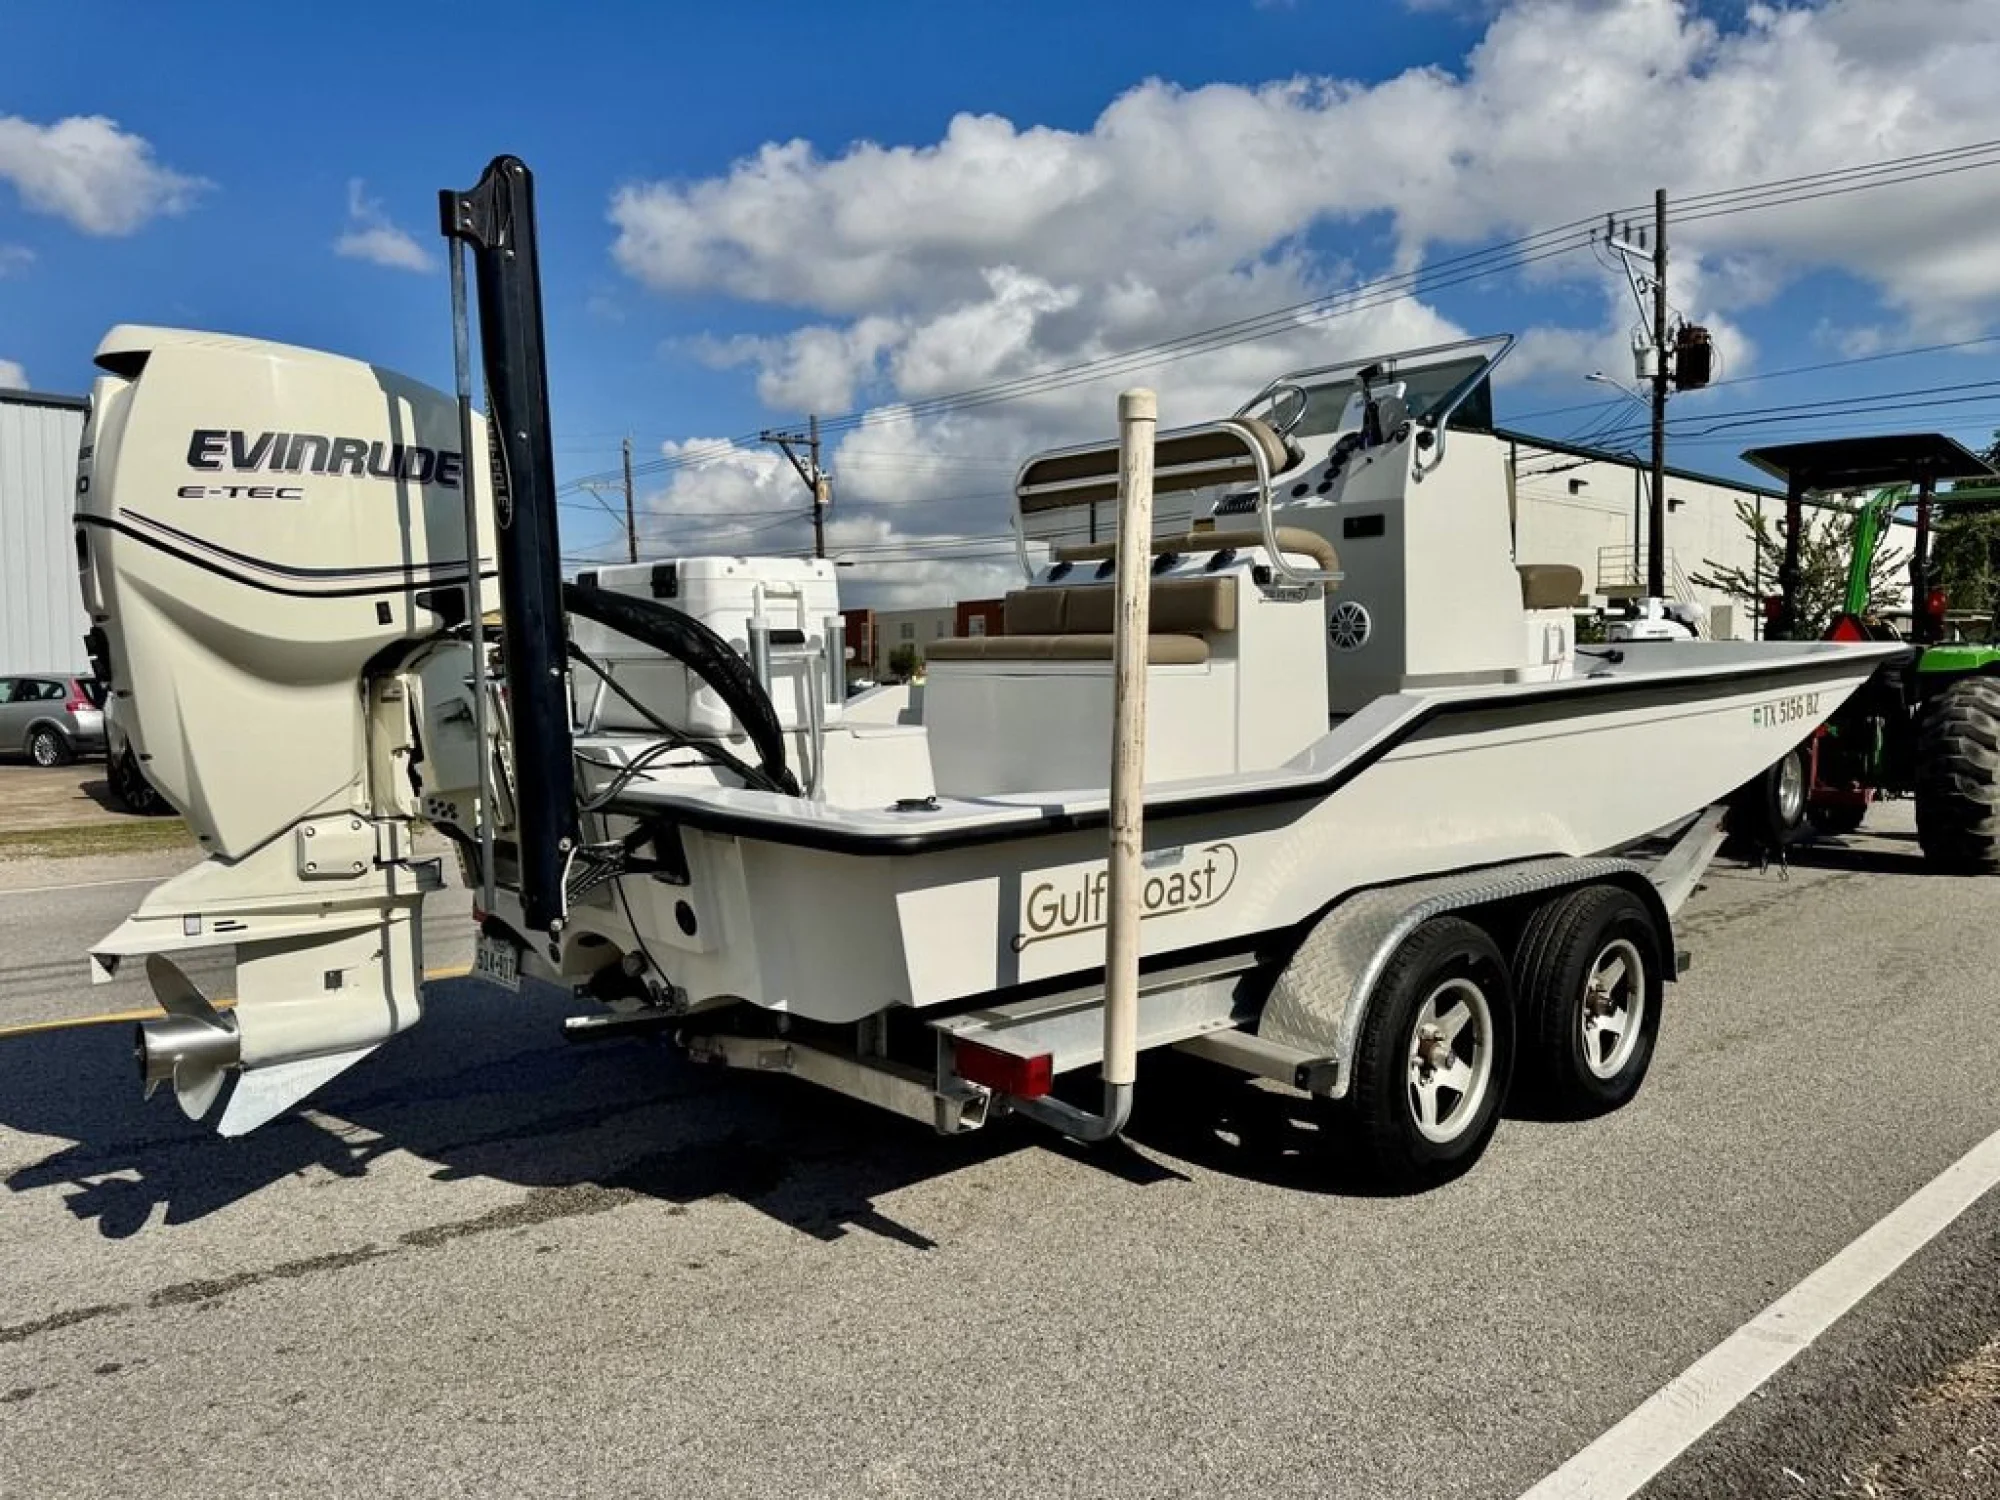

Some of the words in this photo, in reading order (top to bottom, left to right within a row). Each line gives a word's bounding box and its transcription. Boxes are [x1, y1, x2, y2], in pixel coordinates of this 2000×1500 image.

[187, 429, 464, 489] EVINRUDE
[177, 485, 305, 500] E-TEC
[1763, 704, 1777, 728] TX
[1780, 696, 1804, 724] 5156
[1027, 870, 1109, 932] Gulf
[1142, 858, 1216, 910] oast
